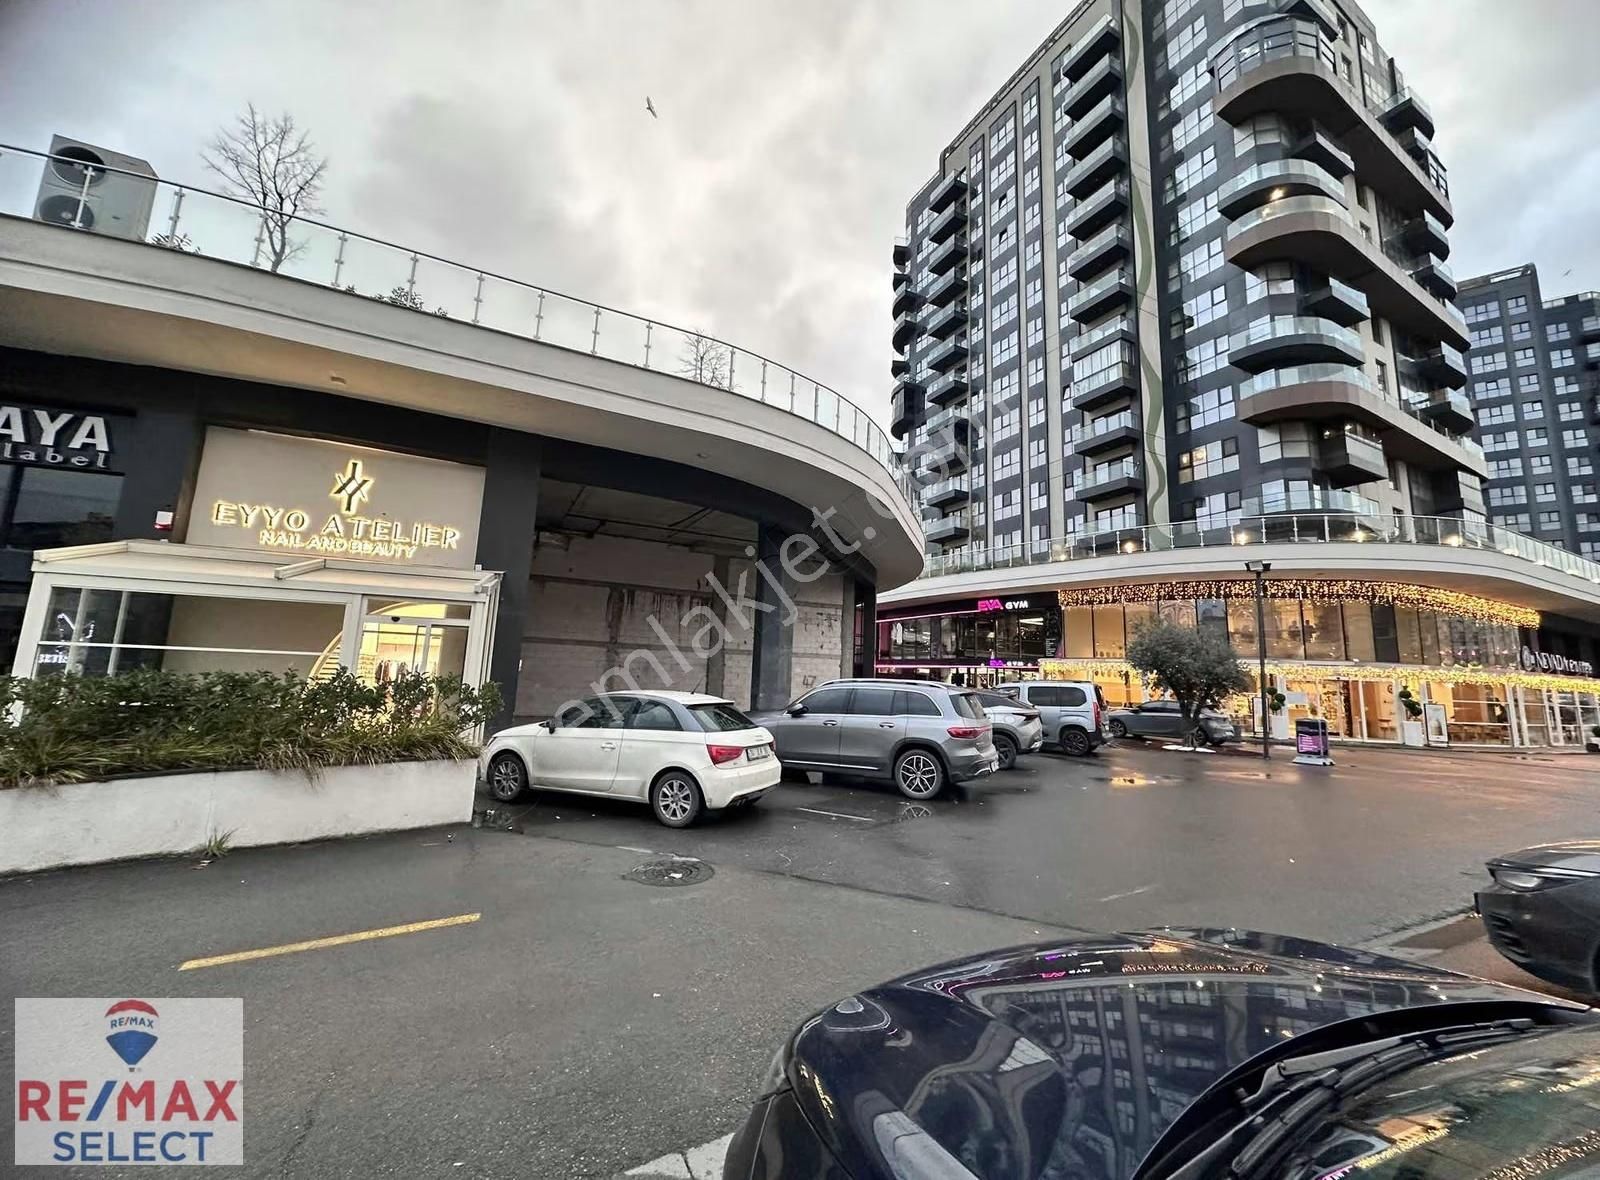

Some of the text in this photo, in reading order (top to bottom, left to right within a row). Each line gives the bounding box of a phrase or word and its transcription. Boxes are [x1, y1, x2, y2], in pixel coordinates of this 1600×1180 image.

[3, 442, 107, 468] label
[214, 502, 461, 549] EYYO ATELIER
[260, 530, 417, 558] NAIL AND BEAUTY
[978, 599, 1029, 611] EVA GYM
